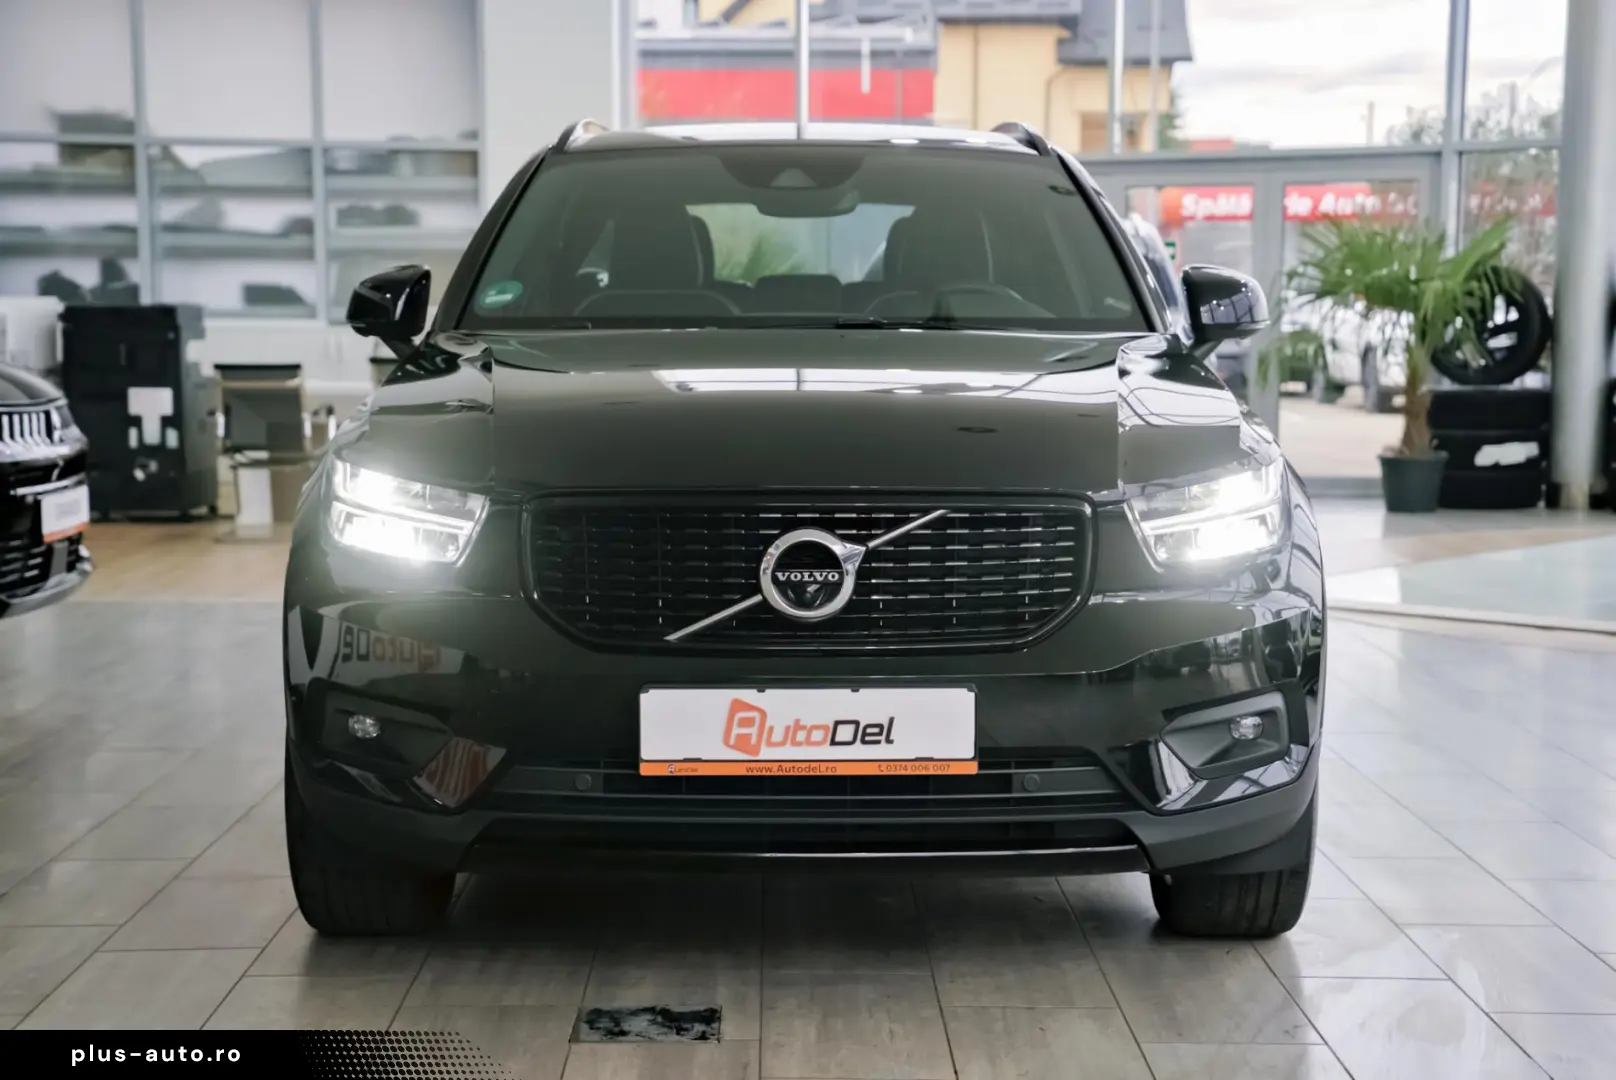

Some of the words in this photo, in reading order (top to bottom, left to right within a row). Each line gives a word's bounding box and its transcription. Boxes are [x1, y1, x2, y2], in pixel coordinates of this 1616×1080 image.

[774, 571, 840, 582] VOLVO
[723, 698, 895, 758] AutoDel
[745, 763, 838, 775] www.Autodel.ro
[885, 763, 908, 773] 0374
[910, 763, 930, 773] 006
[932, 763, 951, 773] 007
